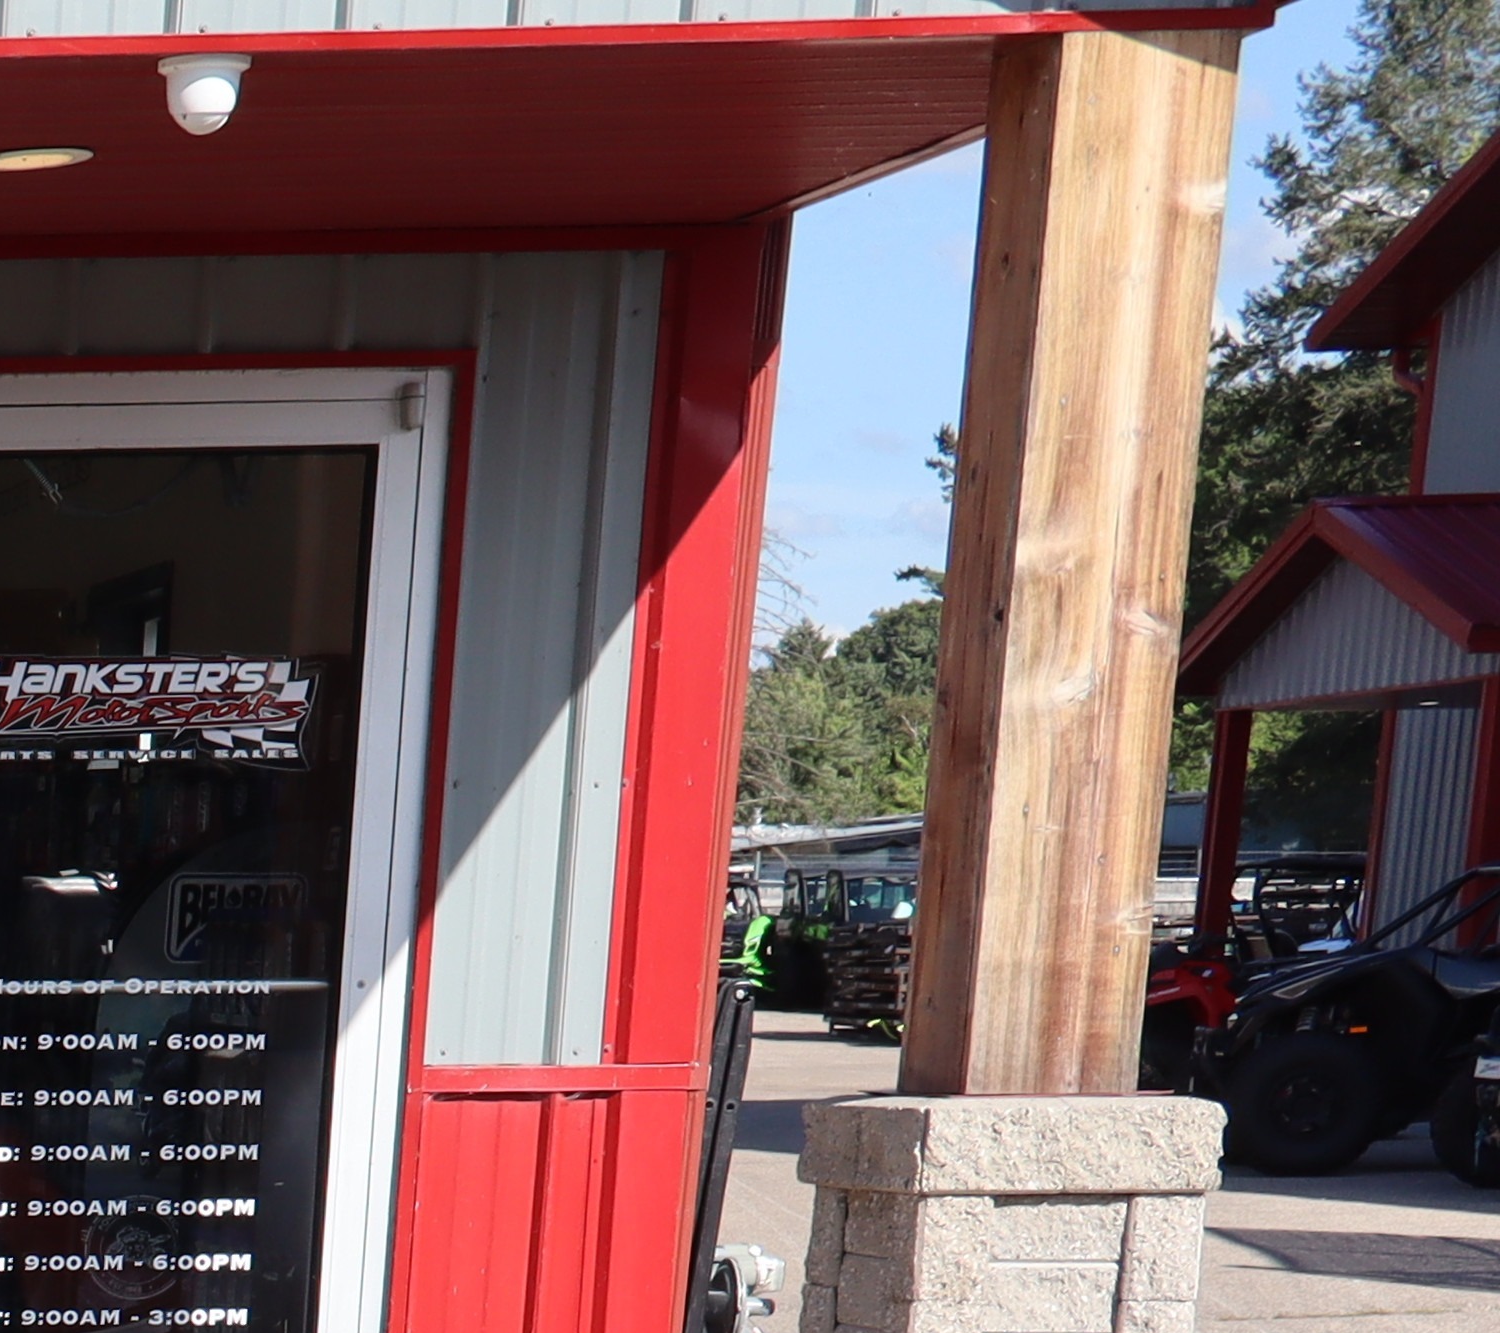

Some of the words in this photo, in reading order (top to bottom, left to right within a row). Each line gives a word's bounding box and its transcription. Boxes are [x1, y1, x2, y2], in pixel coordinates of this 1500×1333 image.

[214, 748, 300, 760] SALES
[83, 979, 115, 996] OF
[124, 977, 271, 996] OPERATION
[166, 1033, 267, 1051] 6:00PM
[33, 1090, 134, 1107] 9:00AM
[162, 1089, 263, 1107] 6:00PM
[30, 1145, 131, 1162] 9:00AM
[159, 1144, 259, 1162] 6:00PM
[27, 1200, 128, 1217] 9:00AM
[155, 1199, 256, 1217] 6:00PM
[24, 1255, 125, 1272] 9:00AM
[152, 1254, 253, 1272] 6:00PM
[20, 1310, 121, 1327] 9:00AM
[148, 1309, 249, 1327] 3:00PM
